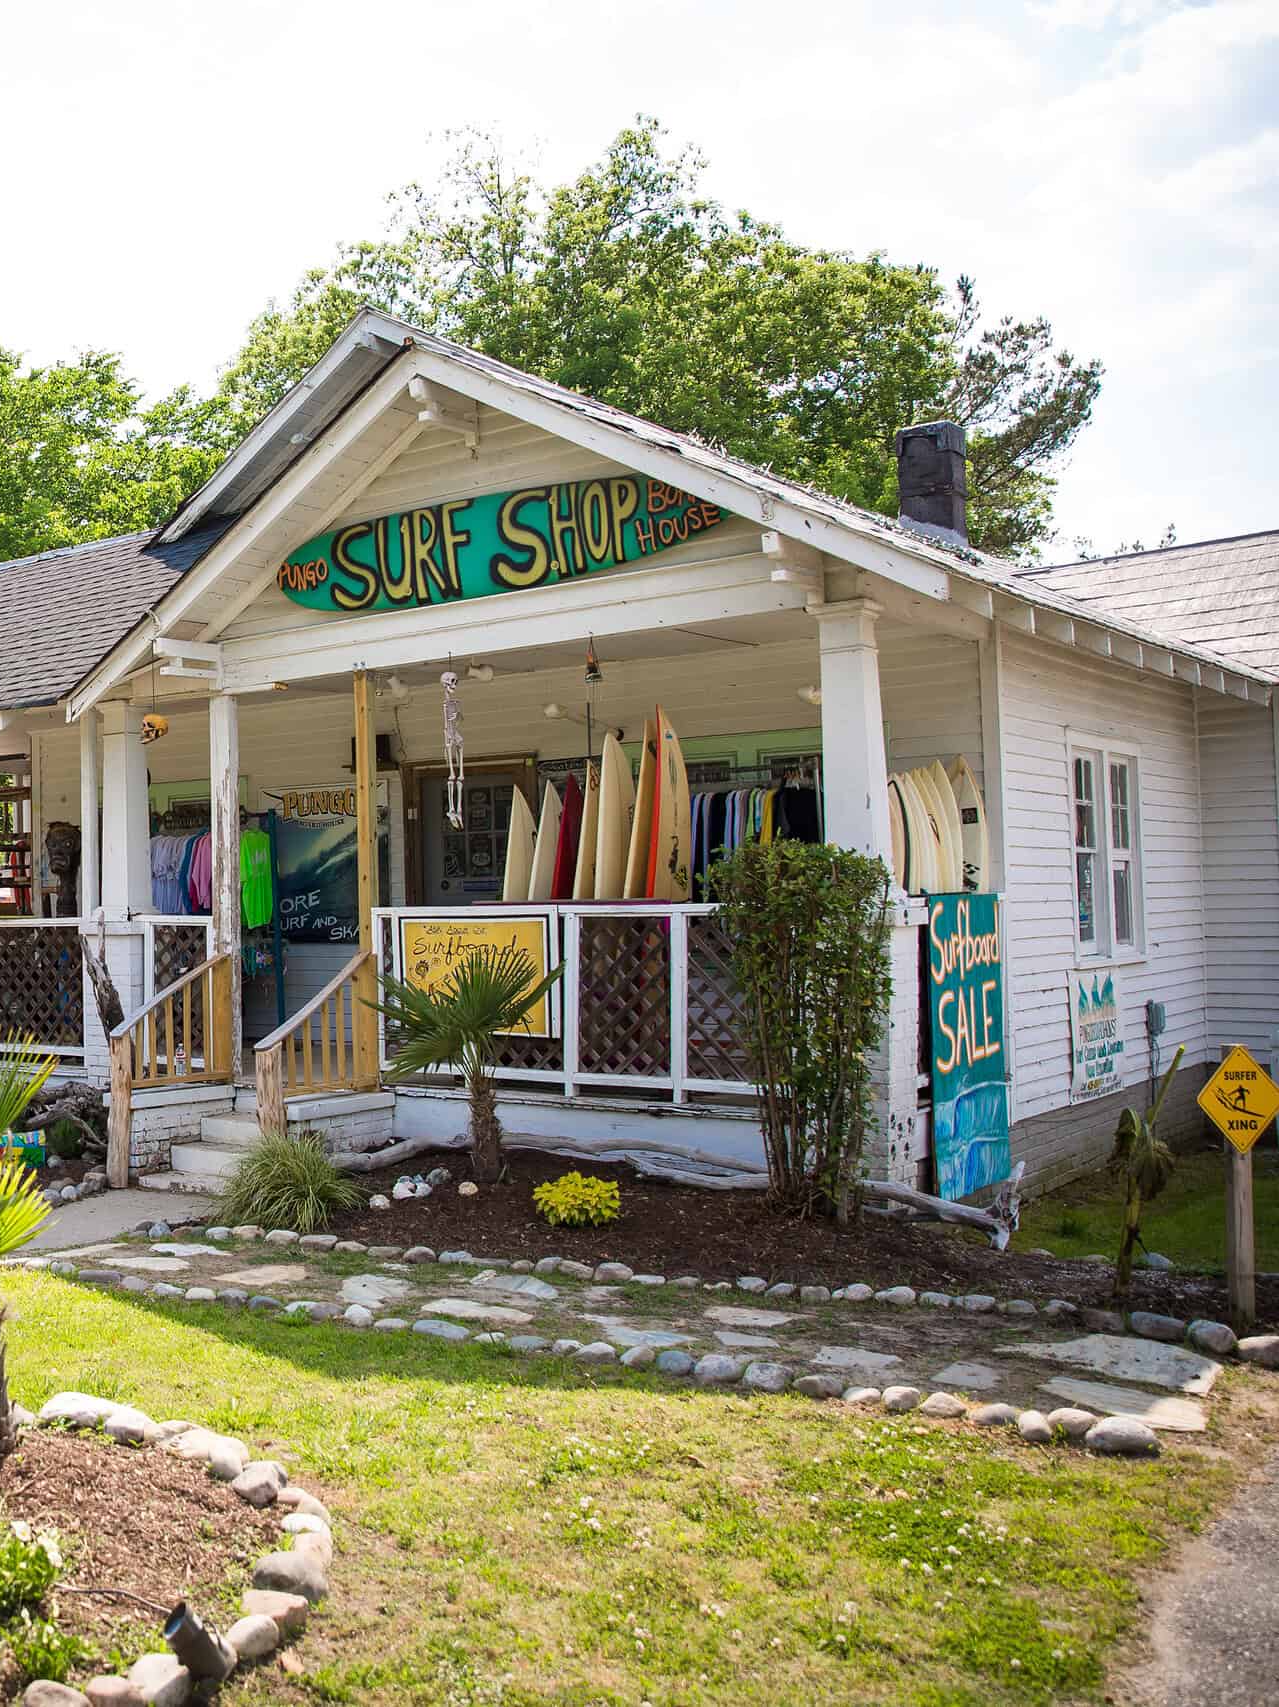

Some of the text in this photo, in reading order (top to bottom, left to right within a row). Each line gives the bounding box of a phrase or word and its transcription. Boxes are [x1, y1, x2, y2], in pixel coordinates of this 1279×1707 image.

[277, 476, 639, 611] PUNGO SURF SHOP
[634, 503, 721, 553] HOUSE
[312, 916, 338, 929] AND
[929, 899, 1001, 985] Surfboard
[936, 980, 1001, 1074] SALE
[1223, 1071, 1257, 1081] SURFER
[1227, 1119, 1258, 1130] XING
